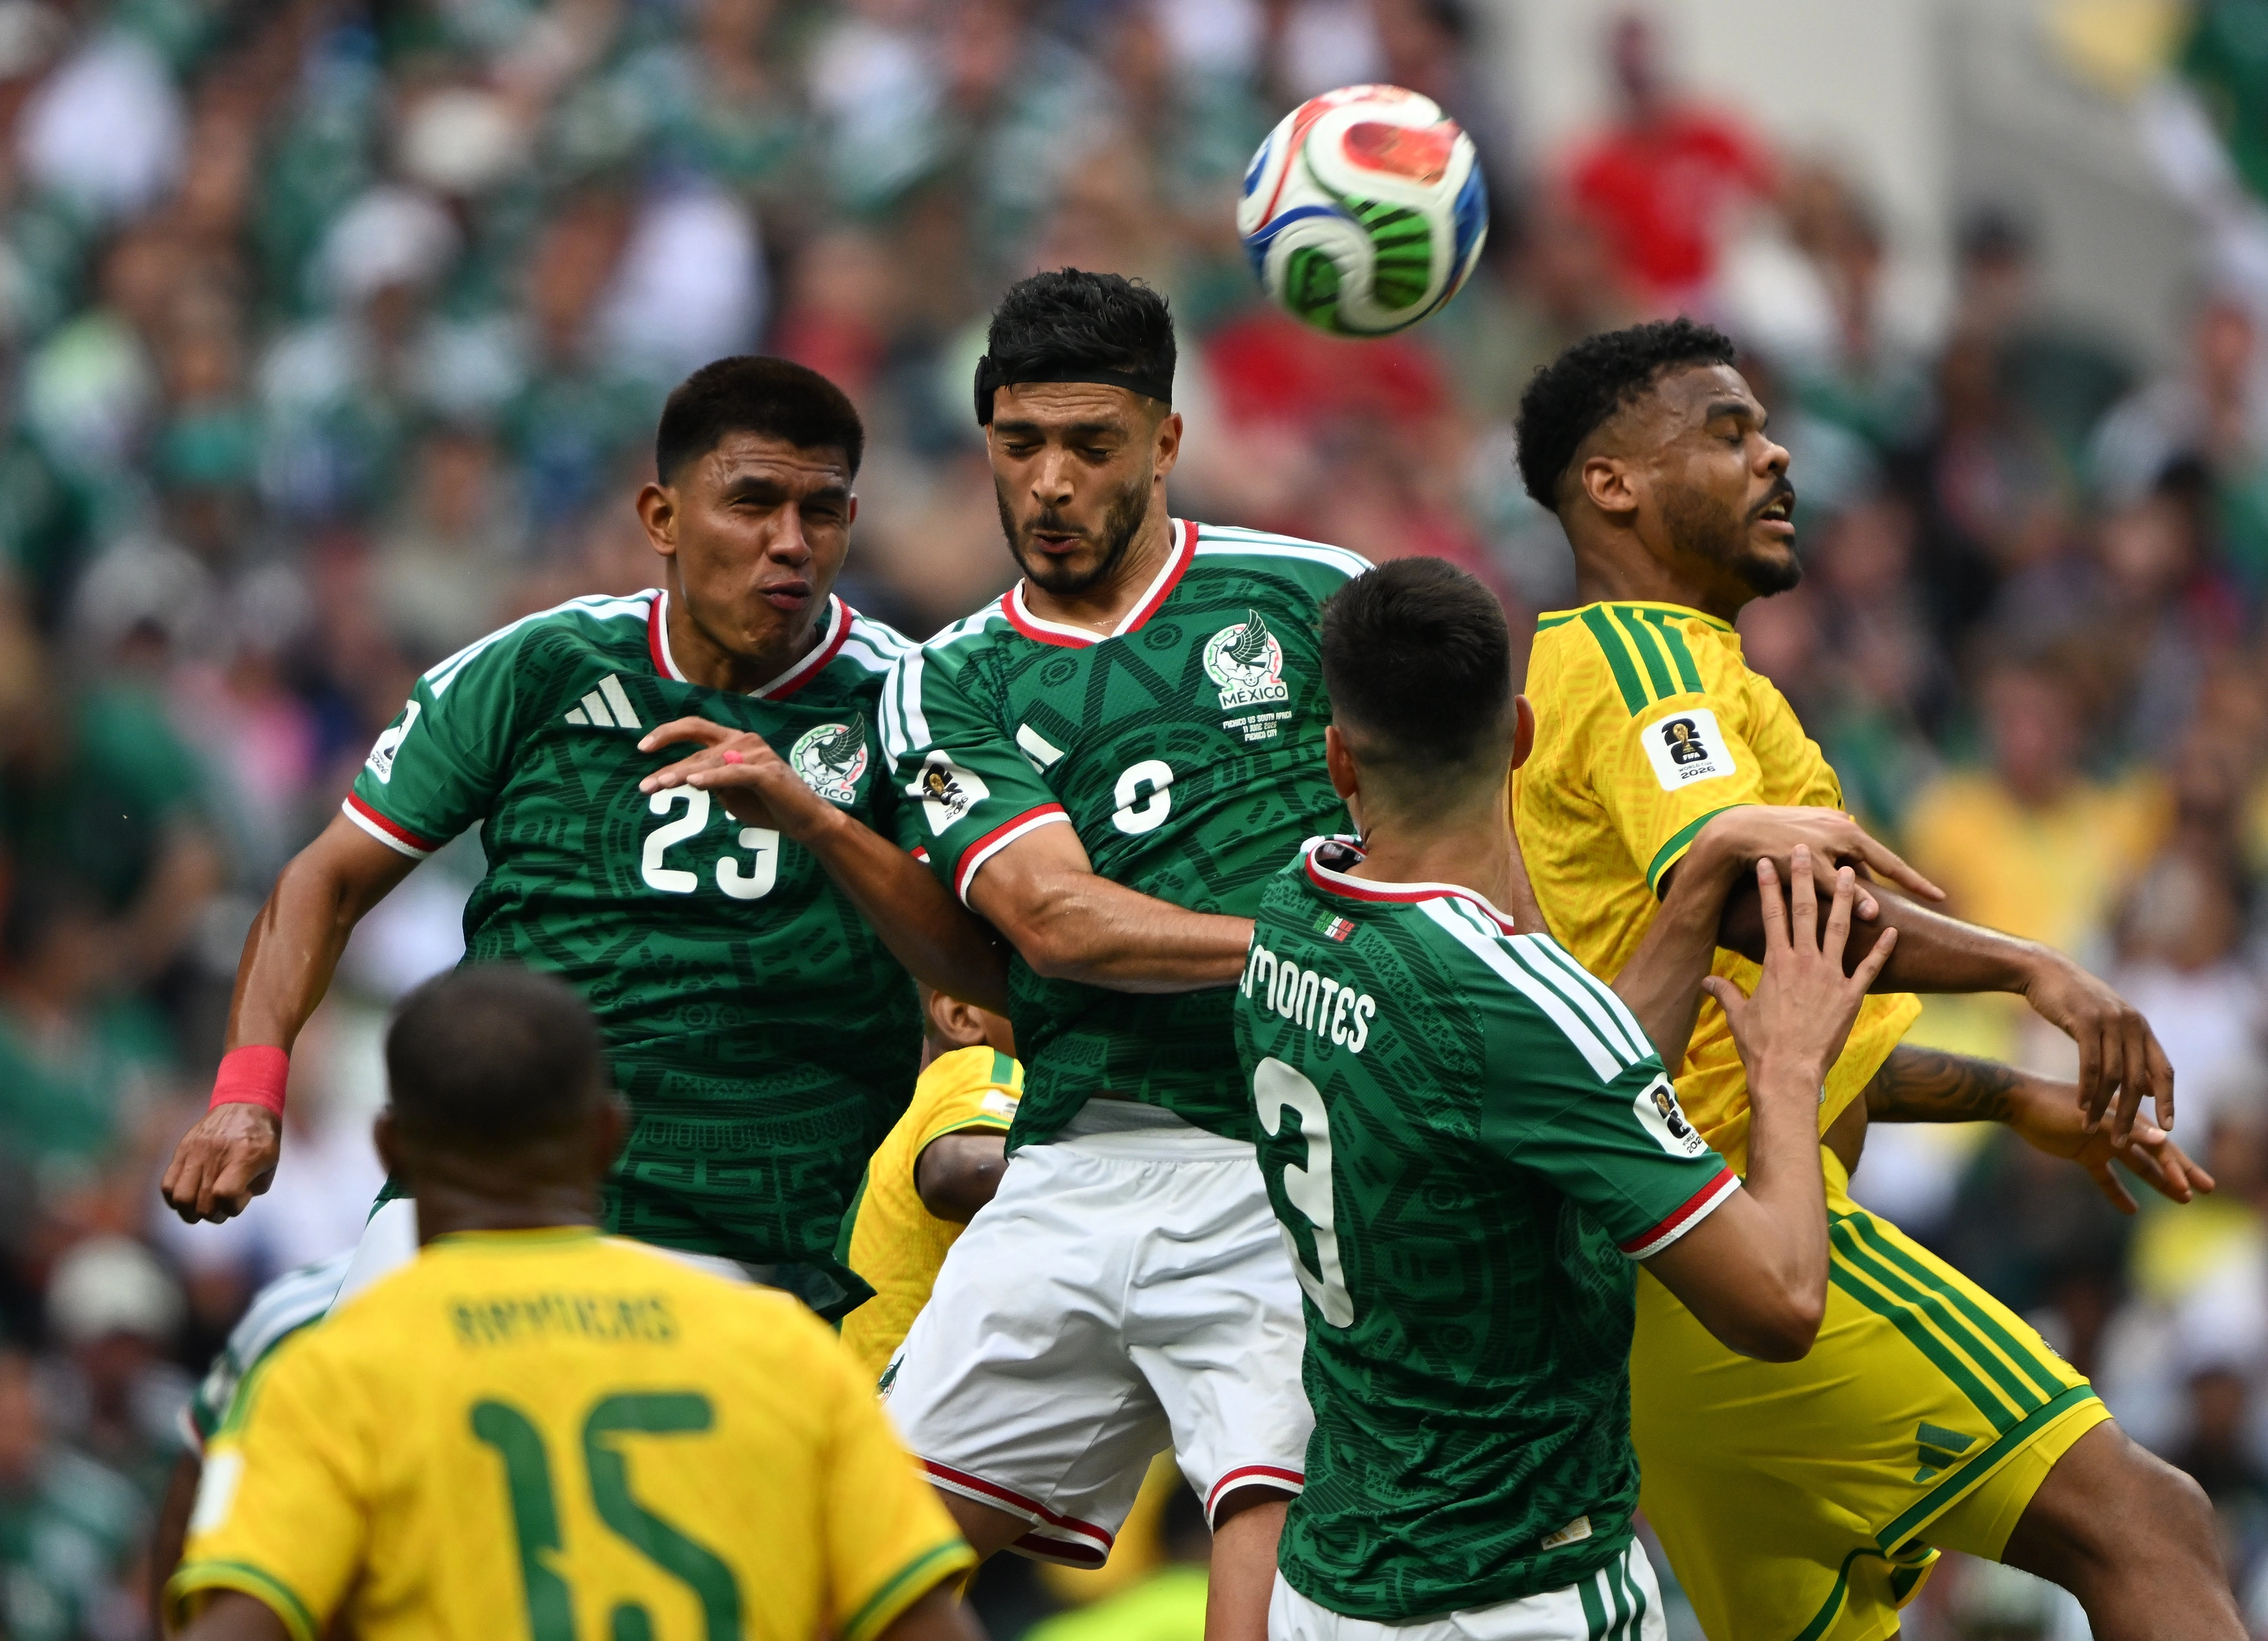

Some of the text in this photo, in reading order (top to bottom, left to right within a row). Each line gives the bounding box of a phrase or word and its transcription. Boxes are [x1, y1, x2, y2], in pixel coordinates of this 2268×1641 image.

[1222, 685, 1286, 707] MÉXICO
[1264, 721, 1277, 730] 2026
[1682, 751, 1700, 760] FIFA
[1679, 763, 1700, 772] WORLD
[1681, 765, 1716, 779] 2026
[806, 780, 853, 801] XICO
[641, 783, 780, 900] 23
[1687, 1136, 1703, 1154] 202
[1254, 1057, 1354, 1329] 3
[472, 1394, 741, 1640] 15
